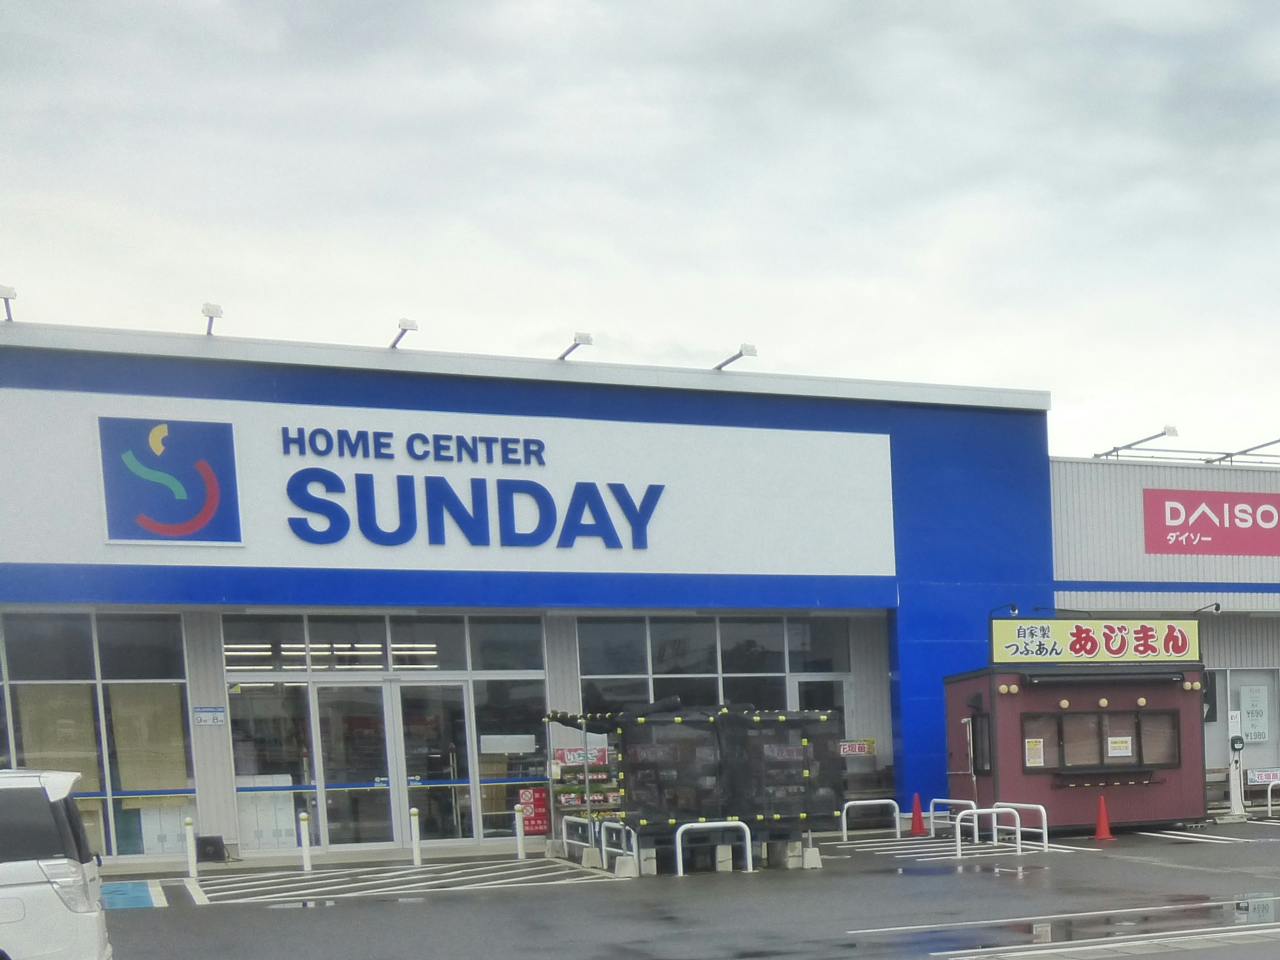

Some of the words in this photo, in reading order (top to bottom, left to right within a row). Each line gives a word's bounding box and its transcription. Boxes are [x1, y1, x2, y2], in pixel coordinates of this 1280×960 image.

[281, 426, 395, 460] HOME
[405, 432, 546, 466] CENTER
[286, 467, 665, 550] SUNDAY
[1165, 501, 1279, 529] DAISO
[1166, 532, 1212, 545] ダイソー
[1016, 625, 1051, 639] 自家製
[1068, 624, 1190, 657] あじまん
[1004, 641, 1063, 657] つぶあん
